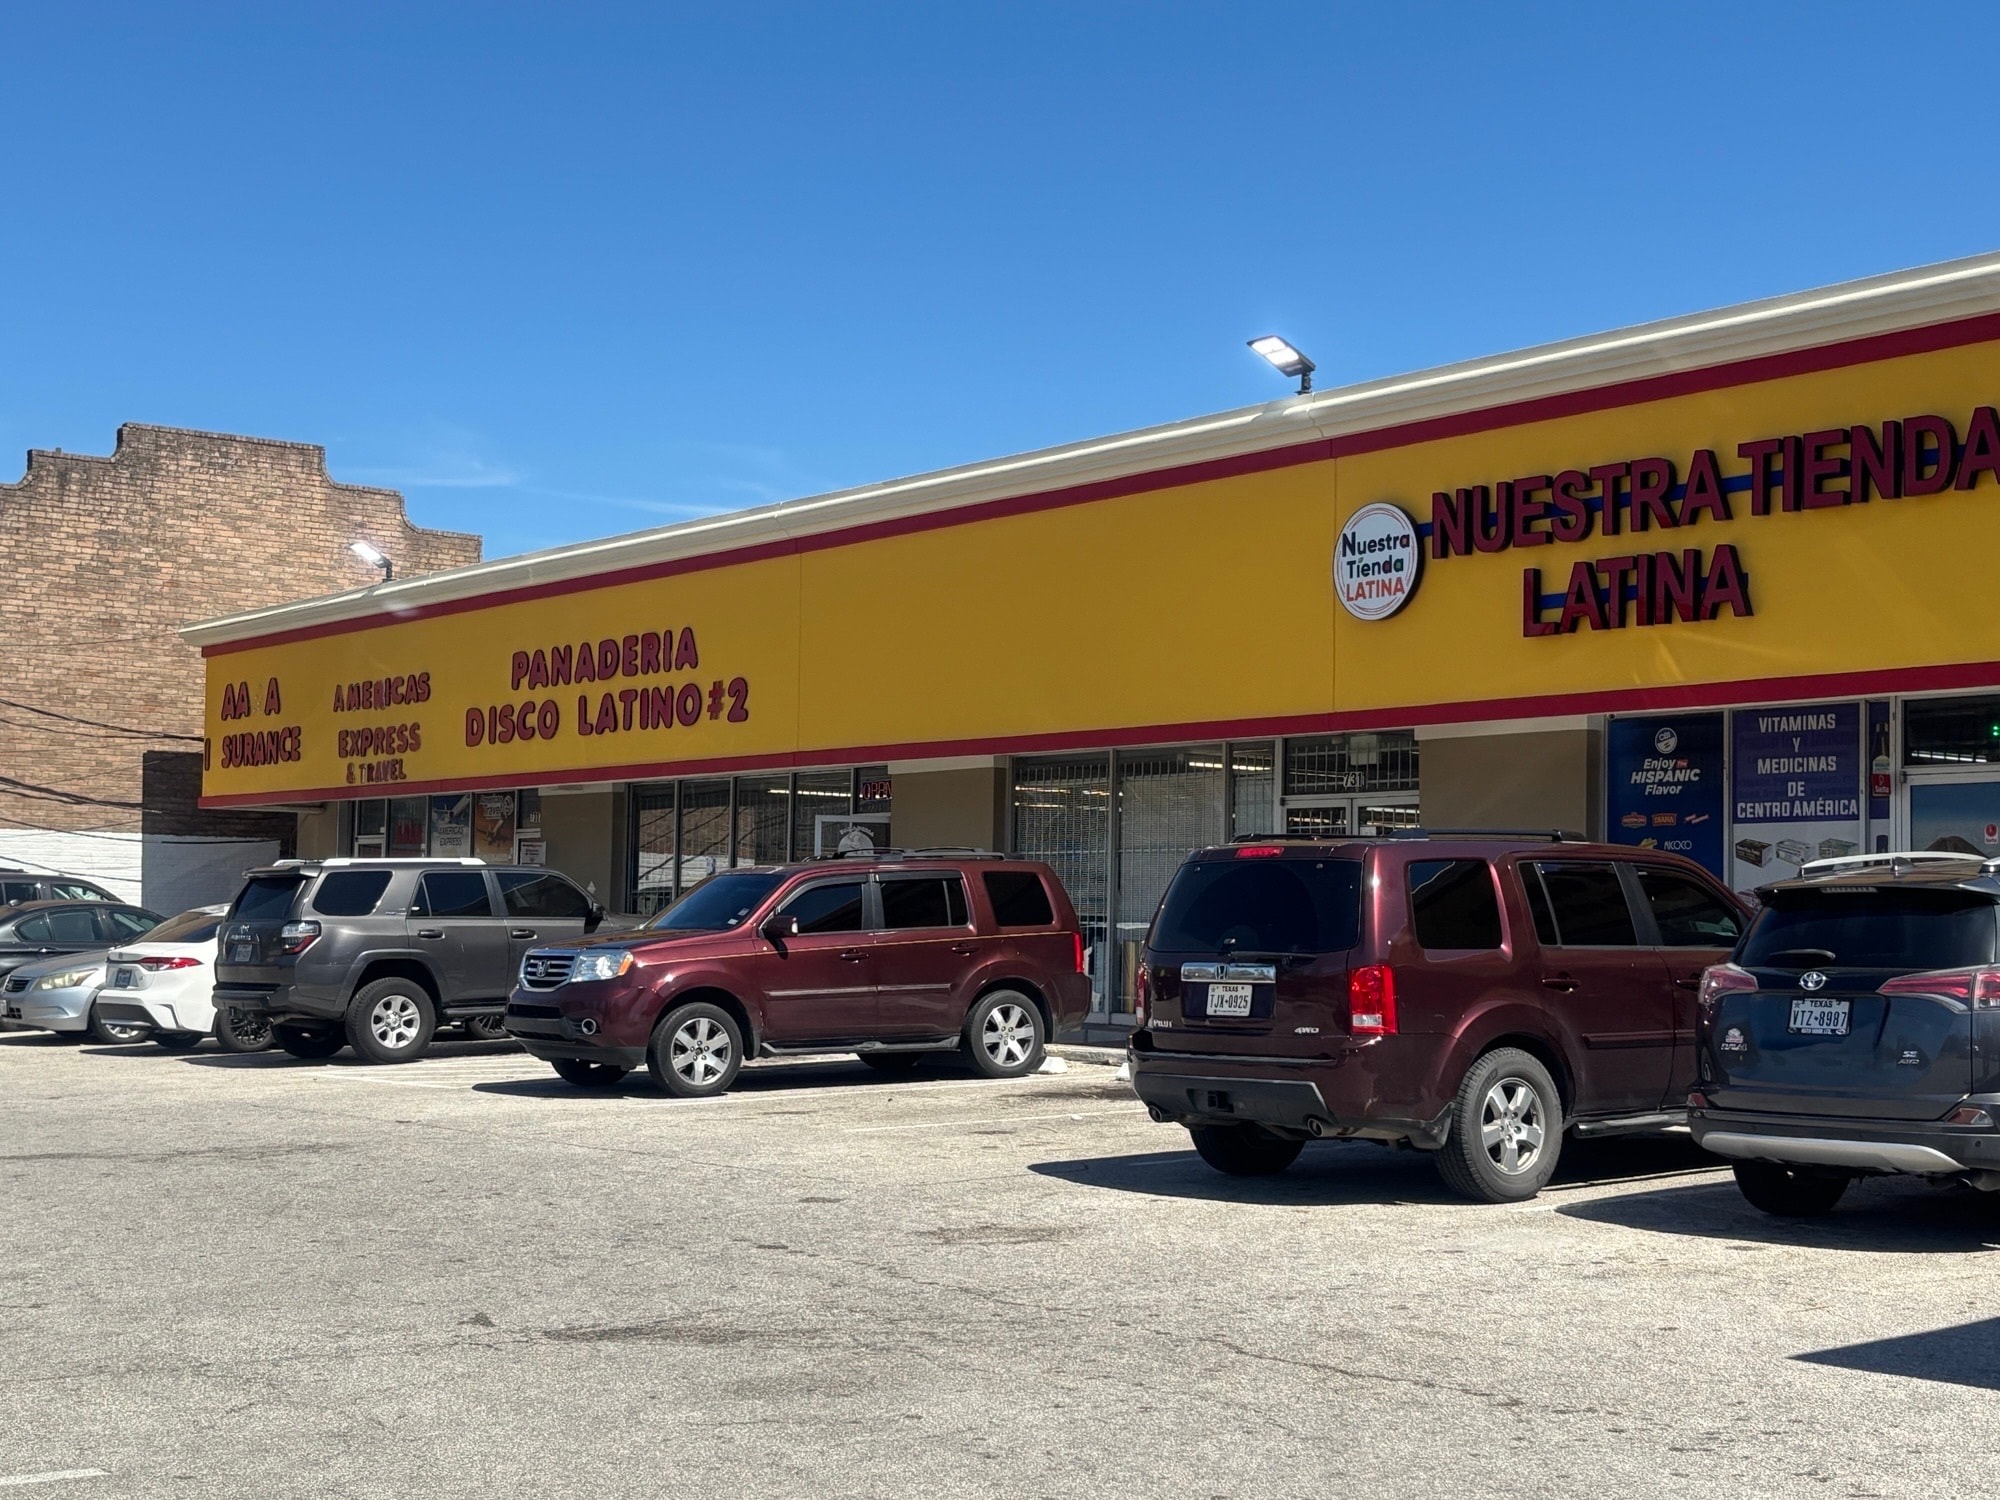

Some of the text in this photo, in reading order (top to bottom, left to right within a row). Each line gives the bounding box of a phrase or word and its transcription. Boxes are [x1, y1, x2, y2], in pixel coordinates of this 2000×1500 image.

[1432, 406, 2000, 559] NUESTRA TIENDA
[1342, 531, 1410, 557] Nuestra
[1346, 577, 1405, 602] LATINA
[1523, 544, 1754, 638] LATINA
[511, 627, 698, 690] PANADERIA
[333, 672, 431, 712] AMERICAS
[465, 699, 560, 747] DISCO
[1758, 713, 1836, 733] VITAMINAS
[338, 722, 422, 758] EXPRESS
[1792, 737, 1801, 753] Y
[359, 758, 407, 784] TRAVEL
[1643, 757, 1677, 771] Enjoy
[1757, 756, 1837, 775] MEDICINAS
[1630, 768, 1701, 784] HISPANIC
[1644, 784, 1682, 796] Flavor
[1787, 781, 1805, 797] DE
[1737, 797, 1858, 819] CENTRO AMÉRICA
[1809, 999, 1833, 1008] TEXAS
